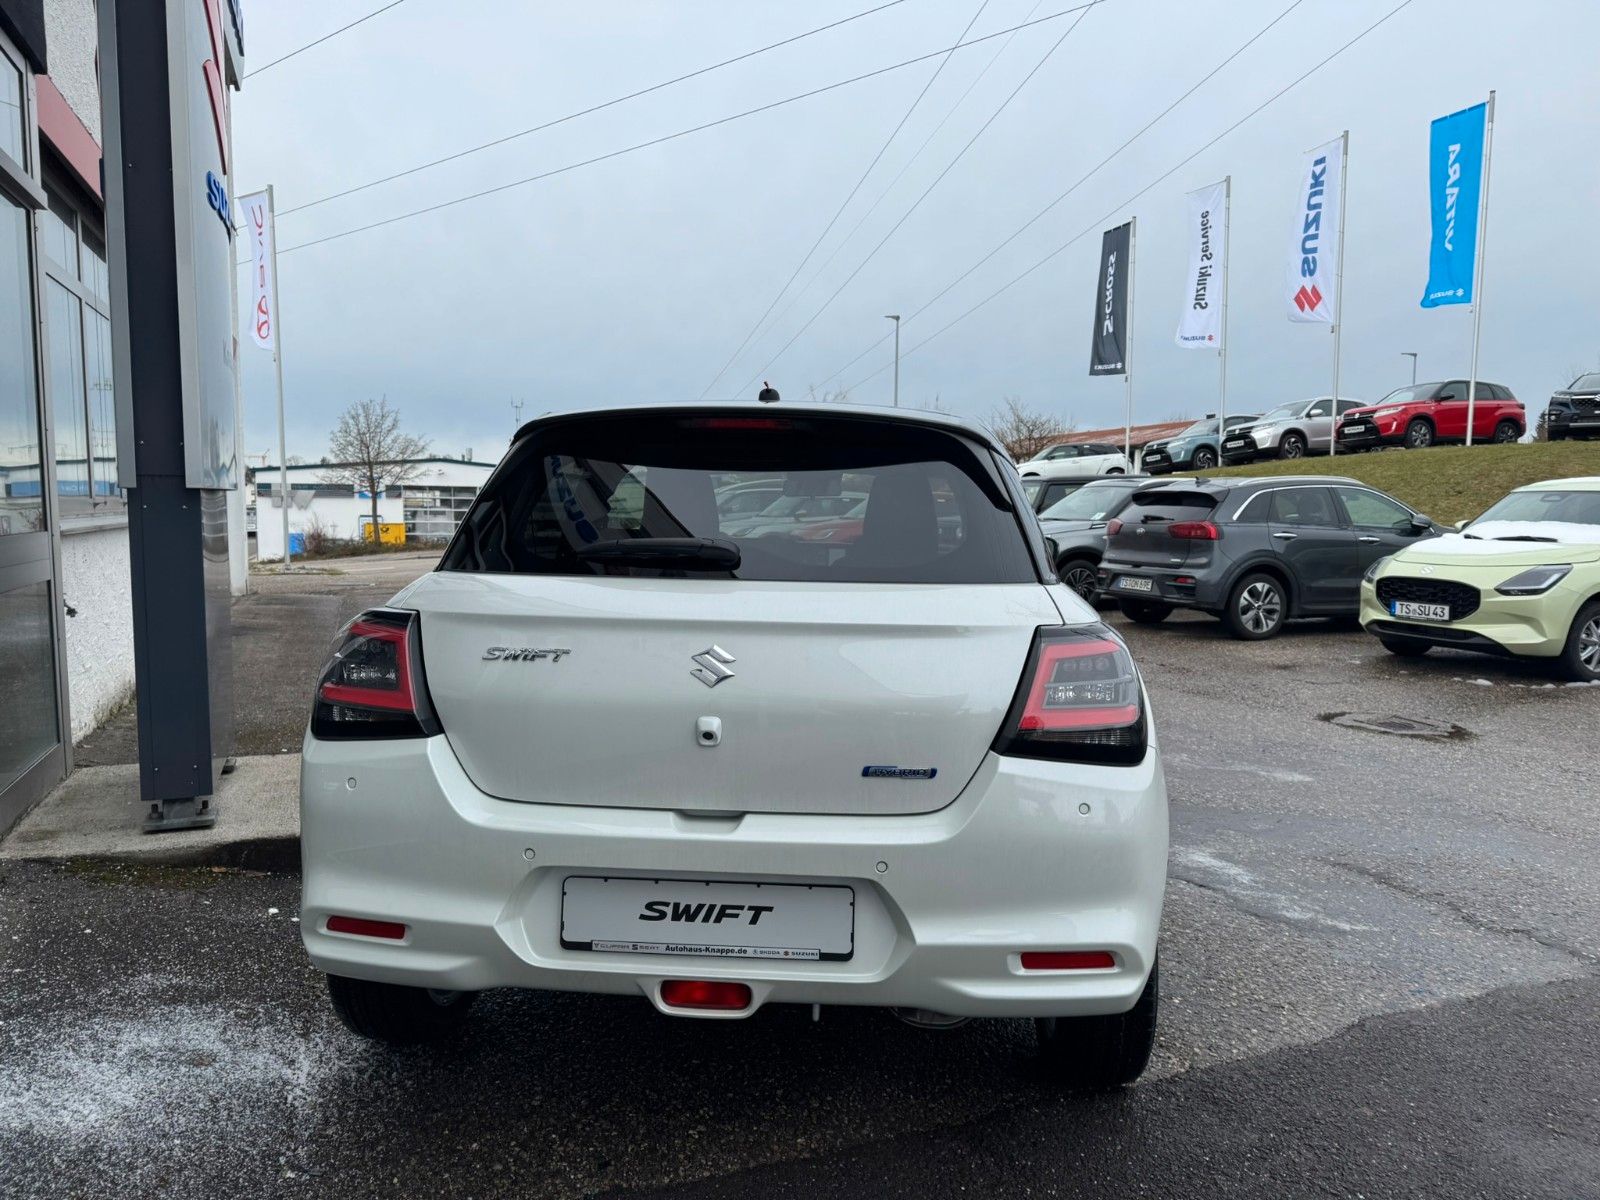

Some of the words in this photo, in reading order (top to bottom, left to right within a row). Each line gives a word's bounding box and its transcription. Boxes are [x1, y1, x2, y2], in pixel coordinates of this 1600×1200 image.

[1399, 603, 1411, 615] TS
[1417, 605, 1431, 617] SU
[1432, 606, 1446, 618] 43
[482, 646, 571, 663] SWIFT
[639, 900, 774, 926] SWIFT
[665, 944, 748, 956] Autohaus-Knappe.de
